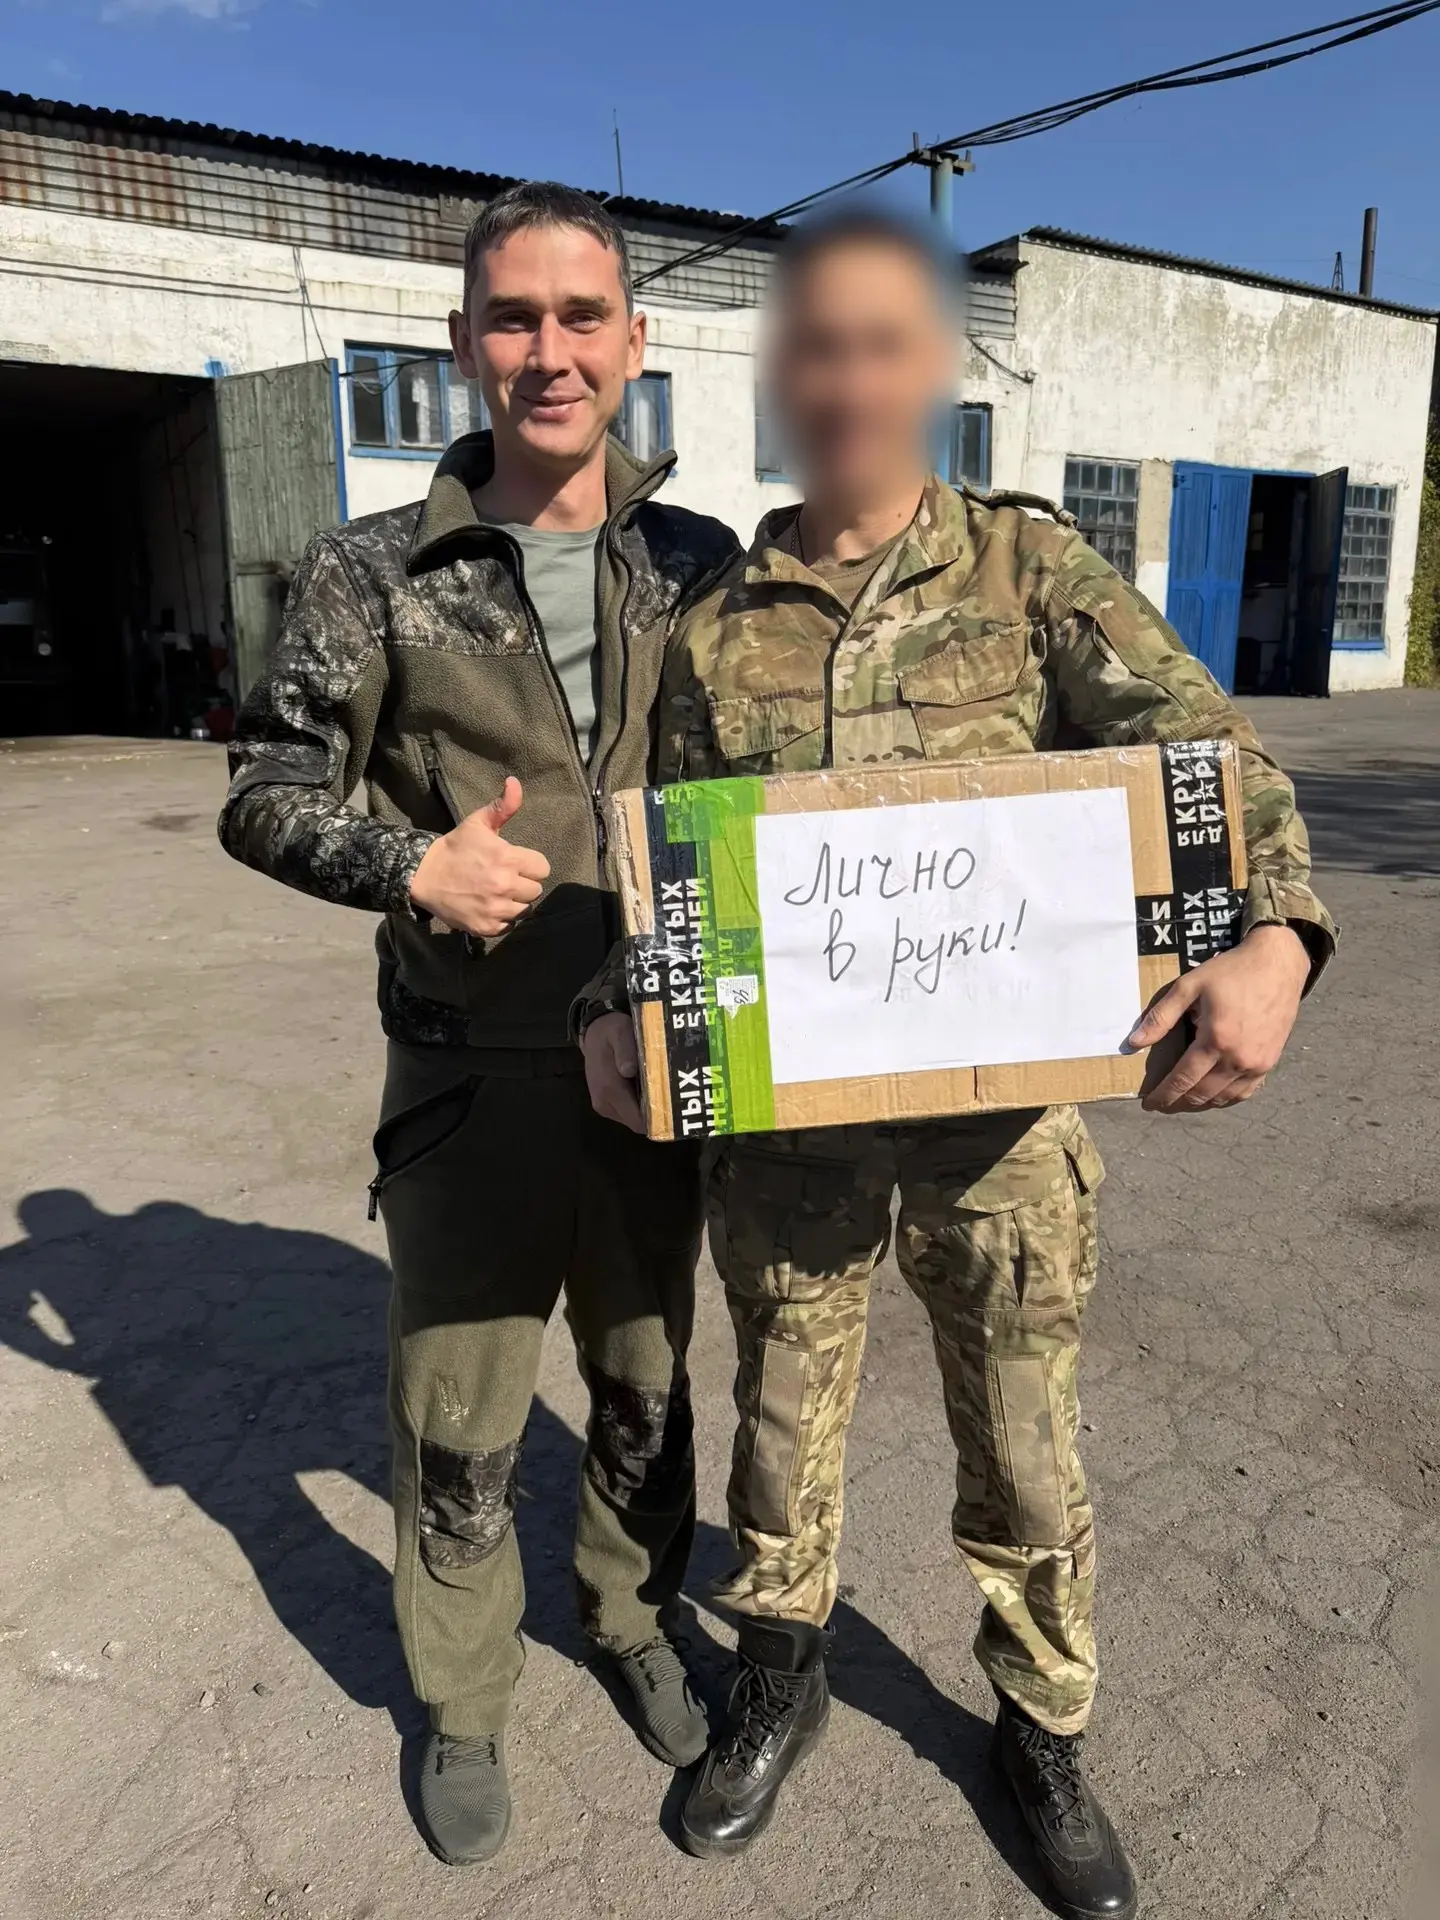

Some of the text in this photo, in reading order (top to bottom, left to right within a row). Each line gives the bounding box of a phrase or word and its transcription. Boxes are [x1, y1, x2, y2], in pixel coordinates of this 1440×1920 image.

[1177, 824, 1223, 847] ДЛЯ
[783, 840, 977, 906] Лично
[661, 880, 692, 1007] КРУТЫХ
[883, 898, 1028, 1004] руки!
[1183, 890, 1209, 968] ТЫХ
[1206, 887, 1233, 958] НЕЙ
[672, 1007, 718, 1029] ДЛЯ
